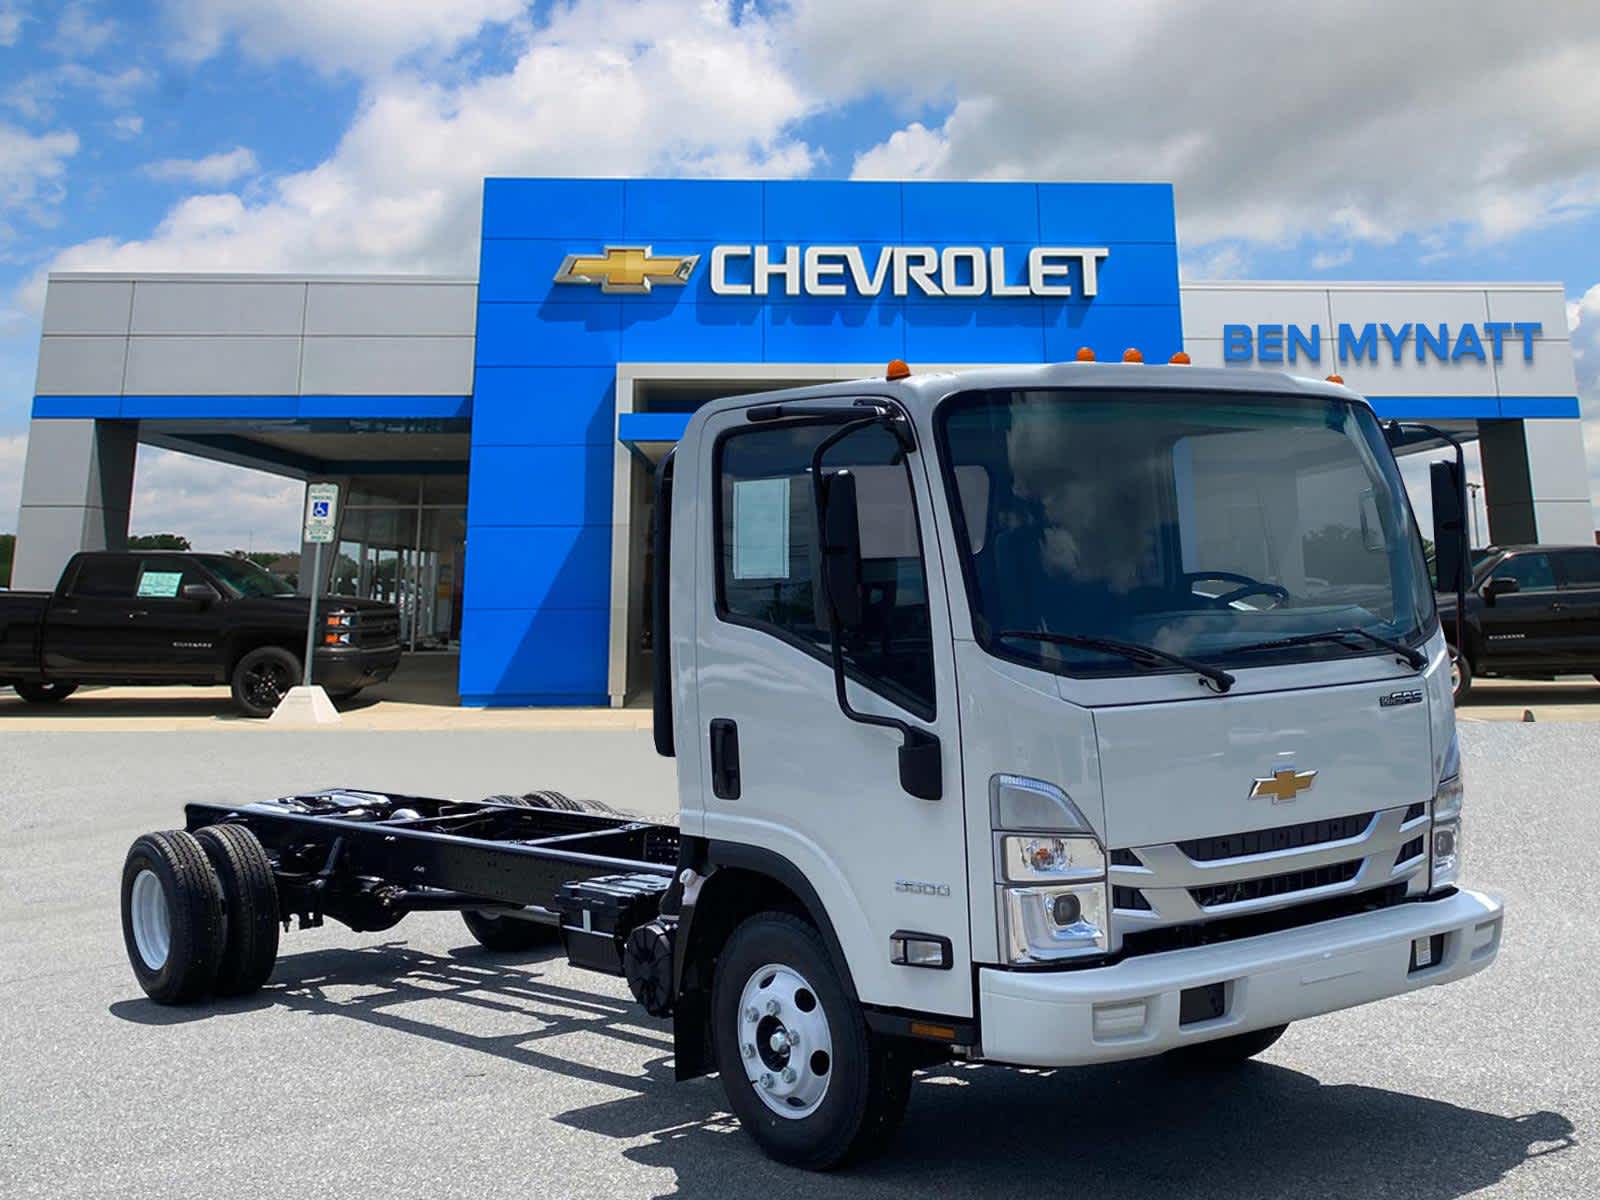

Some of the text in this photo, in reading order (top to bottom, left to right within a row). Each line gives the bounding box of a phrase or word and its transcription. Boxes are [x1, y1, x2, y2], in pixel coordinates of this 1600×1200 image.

[710, 245, 1109, 297] CHEVROLET
[1223, 322, 1542, 362] BEN MYNATT
